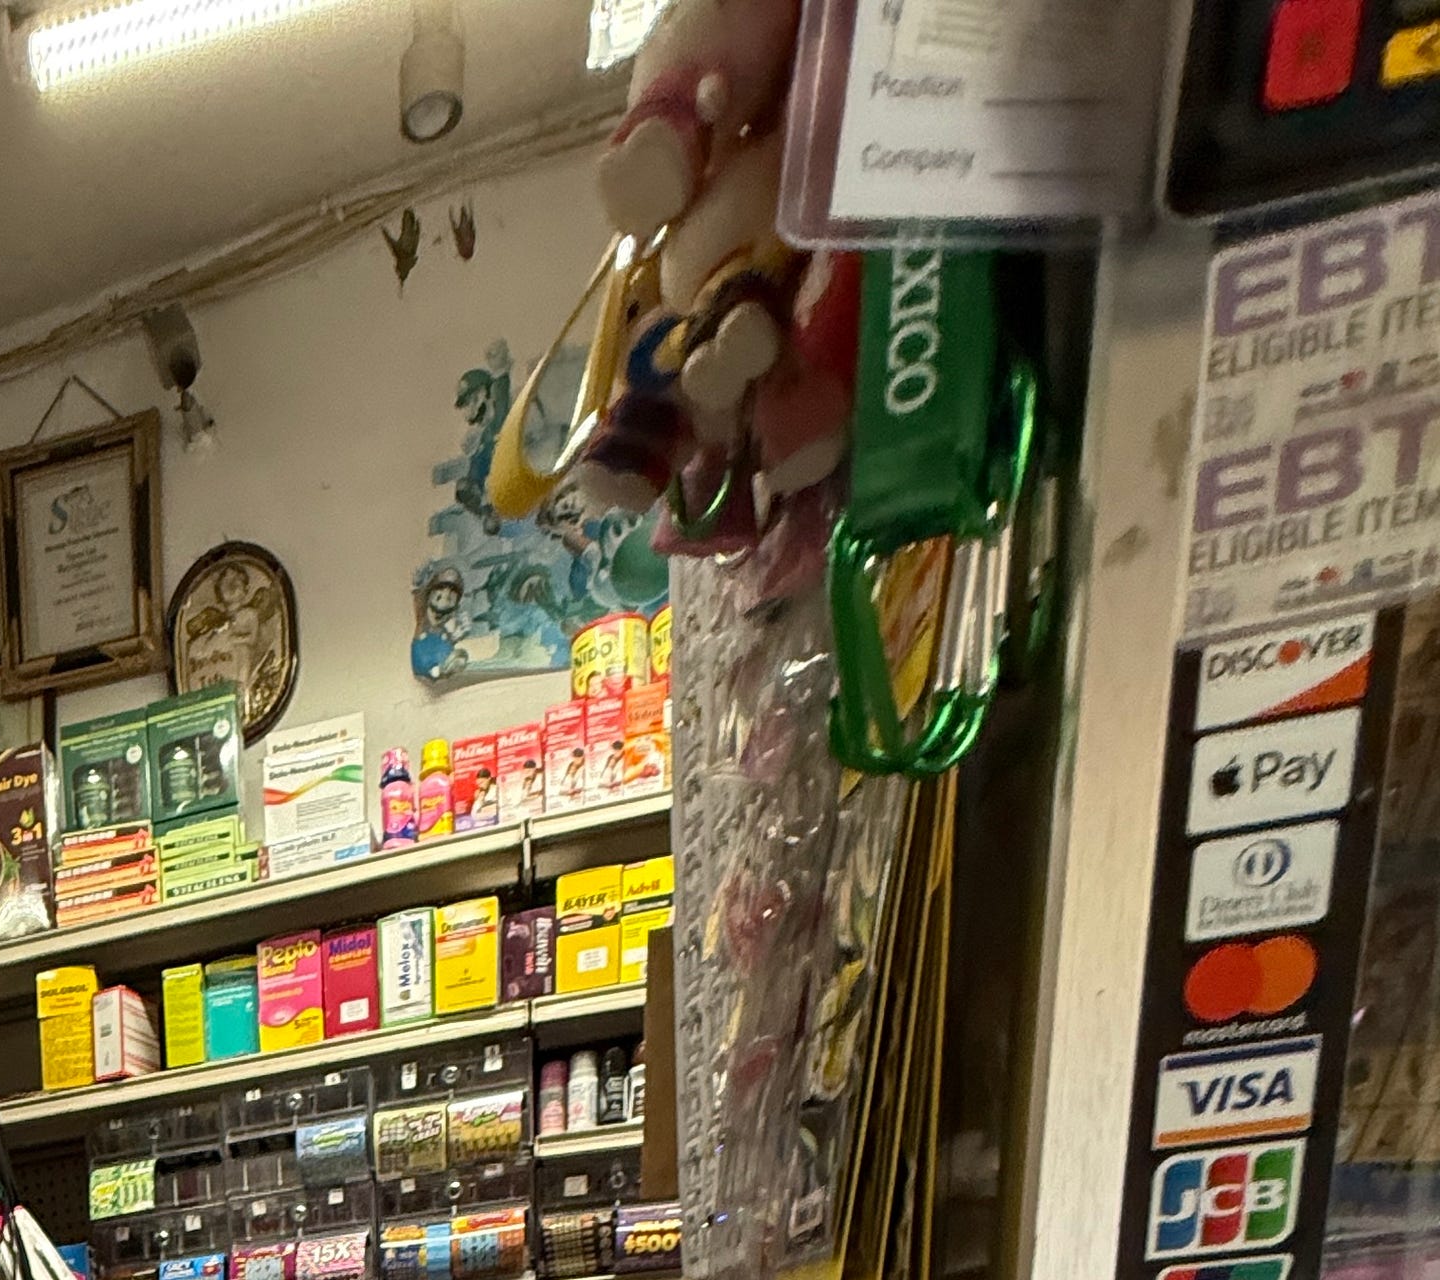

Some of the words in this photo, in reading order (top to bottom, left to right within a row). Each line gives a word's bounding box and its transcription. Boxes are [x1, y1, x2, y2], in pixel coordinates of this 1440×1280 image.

[1379, 290, 1440, 341] ITE
[1194, 400, 1440, 534] EBT
[1189, 504, 1350, 577] ELIGIBLE
[1355, 487, 1440, 537] ITEM
[1207, 620, 1365, 682] DISCOVER
[13, 771, 39, 790] Dye
[1252, 747, 1340, 794] Pay
[259, 937, 318, 967] Pepto
[328, 933, 372, 957] Midol
[1180, 1065, 1295, 1117] VISA
[1155, 1177, 1288, 1223] JCB
